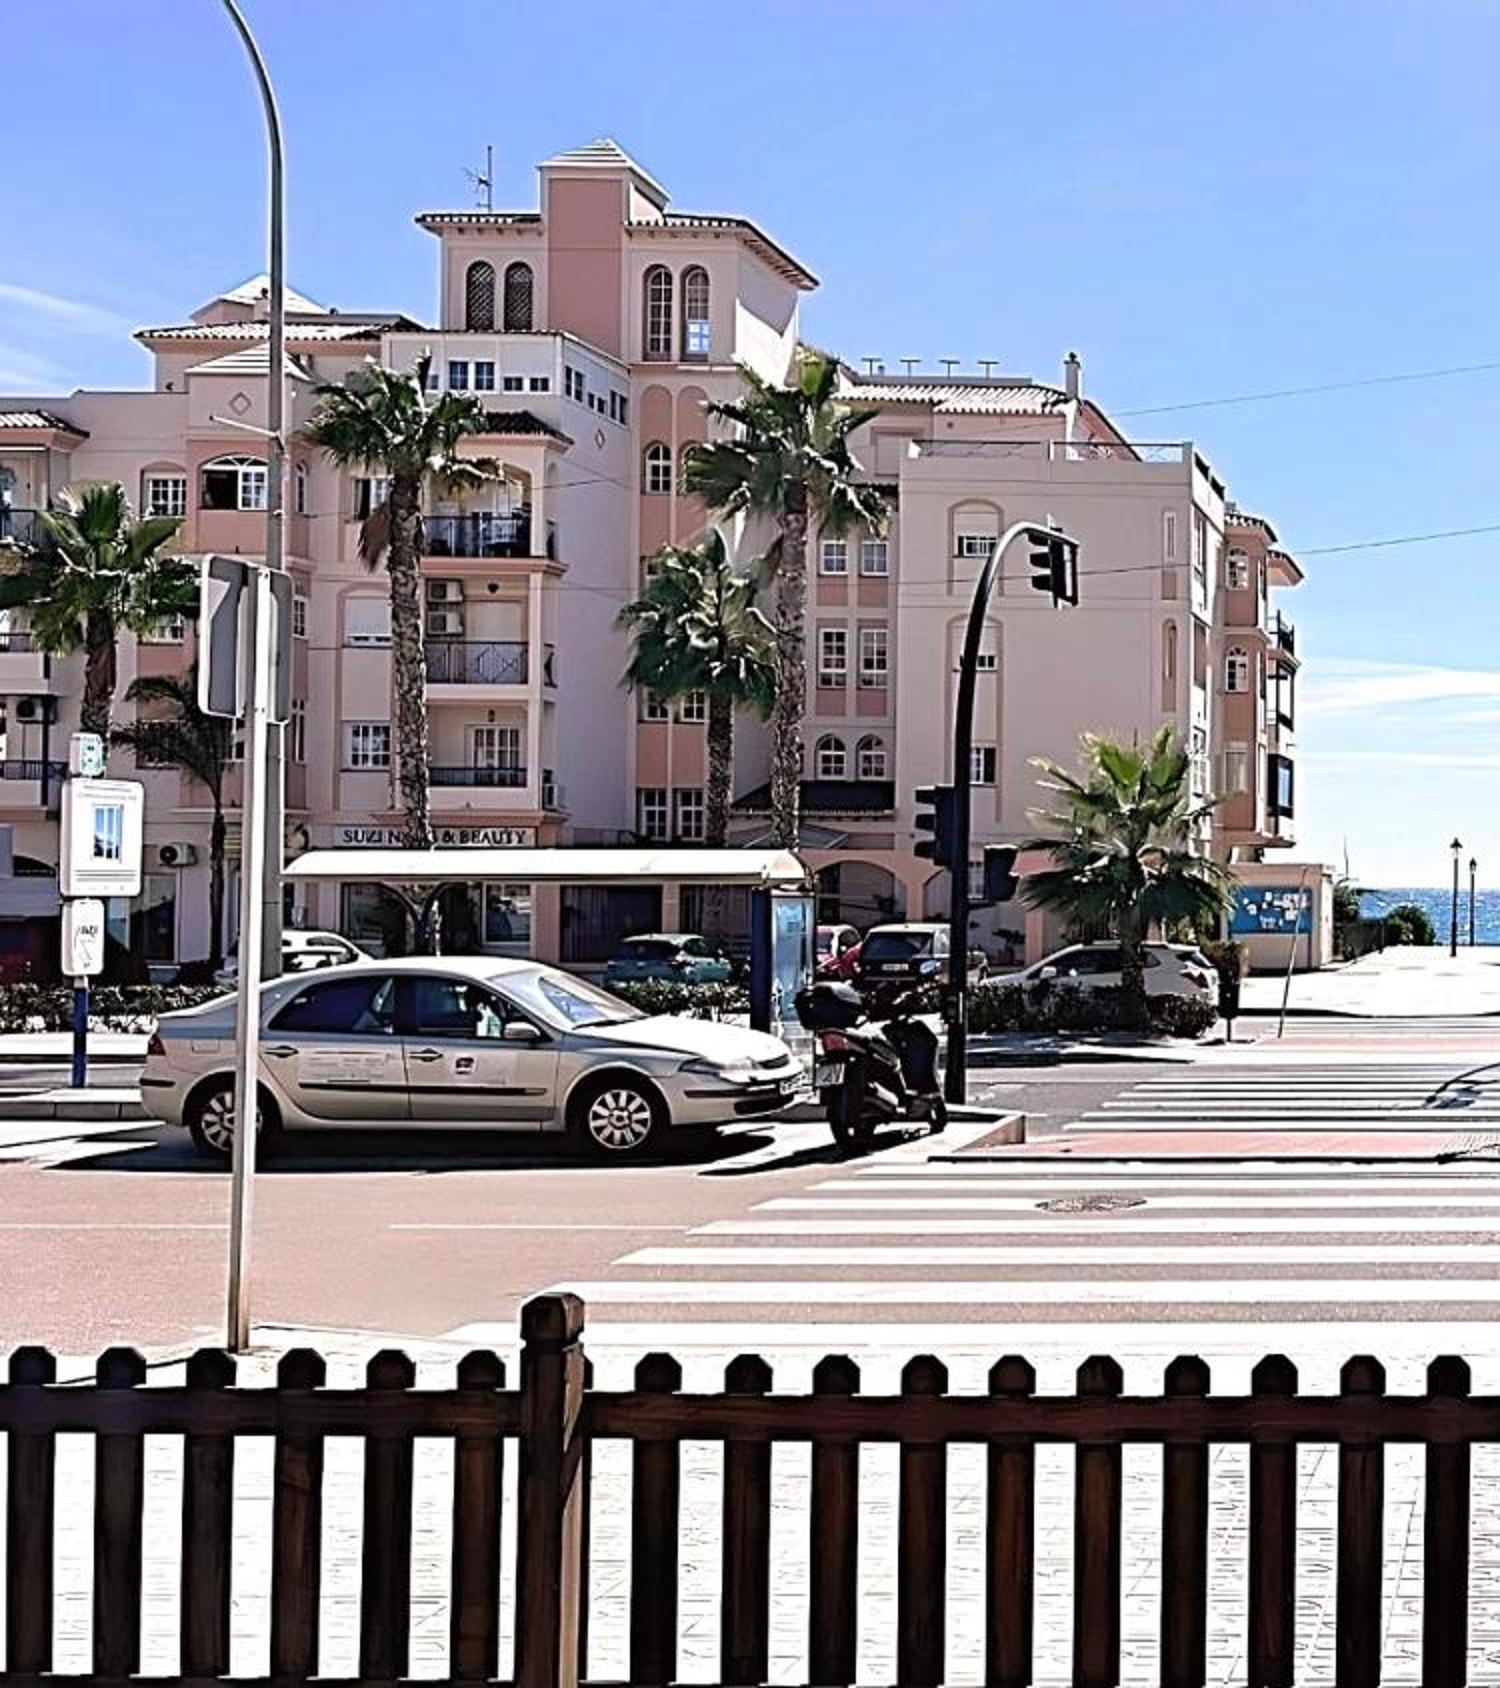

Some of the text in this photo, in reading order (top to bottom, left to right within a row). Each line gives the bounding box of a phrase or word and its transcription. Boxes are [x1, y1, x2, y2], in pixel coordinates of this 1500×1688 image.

[343, 829, 383, 844] SUZI
[442, 830, 456, 844] &
[460, 829, 526, 845] BEAUTY
